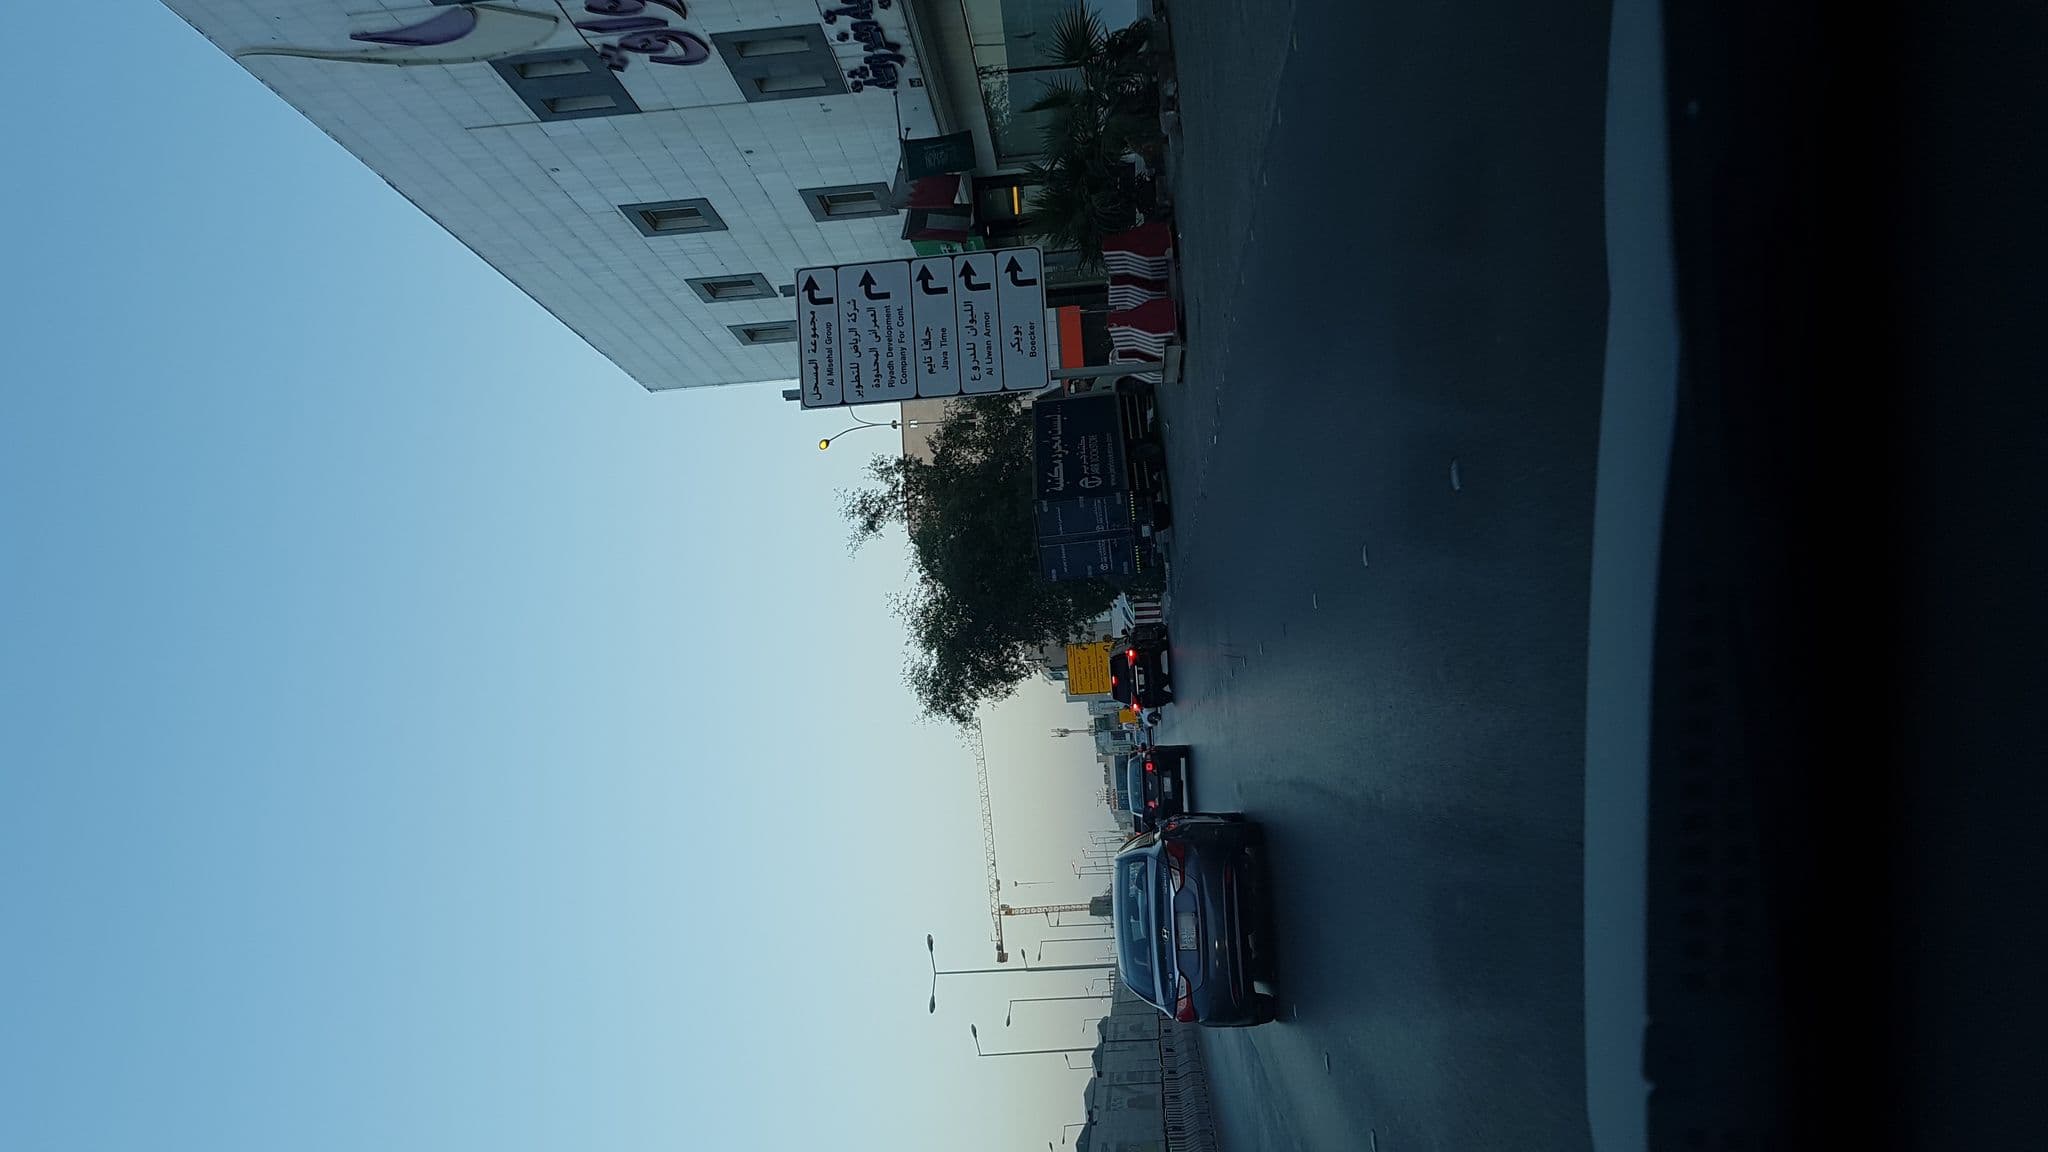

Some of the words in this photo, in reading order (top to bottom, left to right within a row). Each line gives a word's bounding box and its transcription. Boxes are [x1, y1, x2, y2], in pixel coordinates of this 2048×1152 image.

[847, 299, 858, 322] شركة
[963, 301, 977, 336] الليوان
[808, 311, 819, 353] مجموعة
[848, 328, 861, 358] الرياض
[884, 305, 893, 358] Development
[897, 330, 905, 343] For
[1010, 325, 1023, 355] بويكر
[1028, 321, 1037, 357] Boecker
[825, 348, 834, 376] Misehal
[869, 348, 882, 388] المحدودة
[887, 361, 896, 387] Riyadh
[899, 347, 908, 384] Company
[923, 356, 936, 374] تايم
[941, 351, 949, 370] Java
[966, 343, 981, 381] للدروع
[984, 368, 993, 376] Al
[808, 359, 822, 400] المسحل
[850, 363, 864, 398] للتطوير
